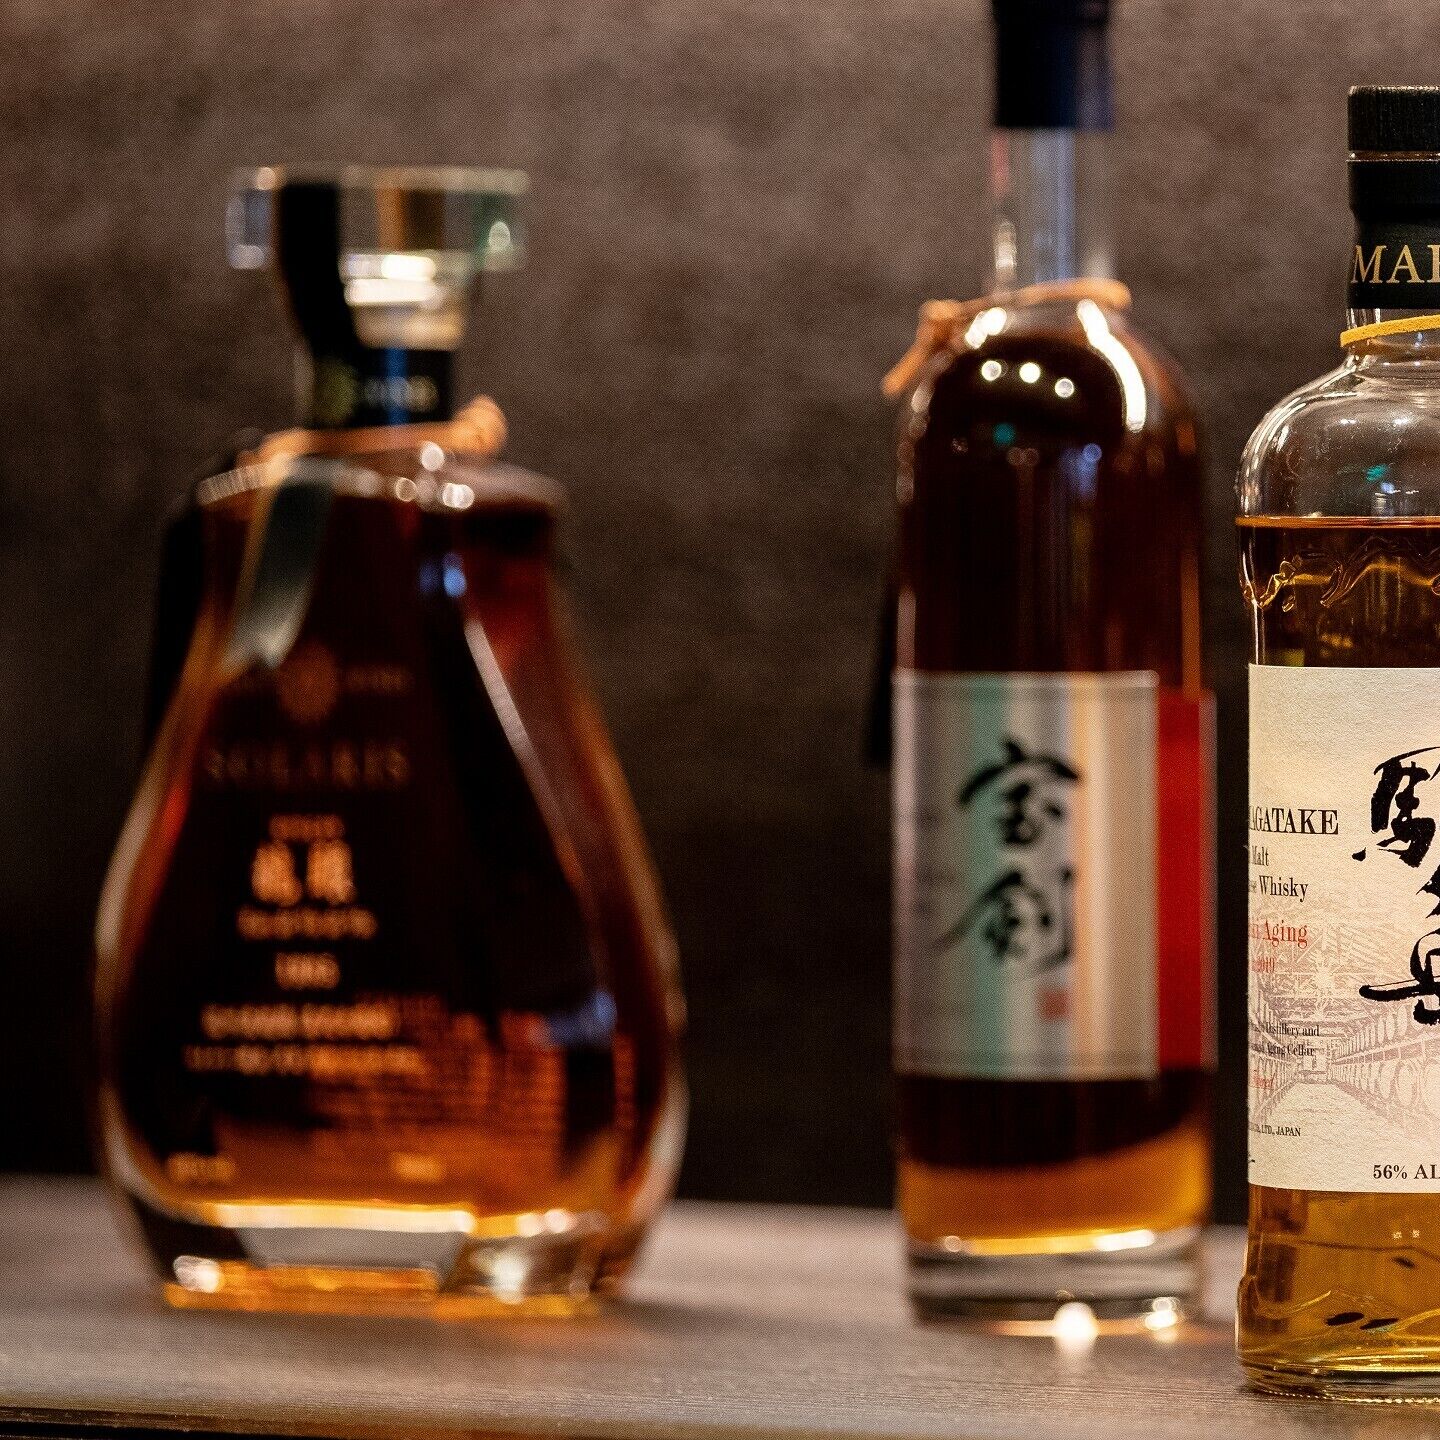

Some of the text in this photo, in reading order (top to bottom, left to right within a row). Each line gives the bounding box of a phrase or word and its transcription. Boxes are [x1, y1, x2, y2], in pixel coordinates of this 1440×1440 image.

[1252, 845, 1269, 867] Malt
[1258, 875, 1309, 903] Whisky
[1262, 918, 1308, 950] Aging
[1302, 1024, 1320, 1037] and
[1287, 1042, 1316, 1058] Cellar
[1275, 1126, 1302, 1138] JAPAN
[1372, 1164, 1408, 1180] 56%
